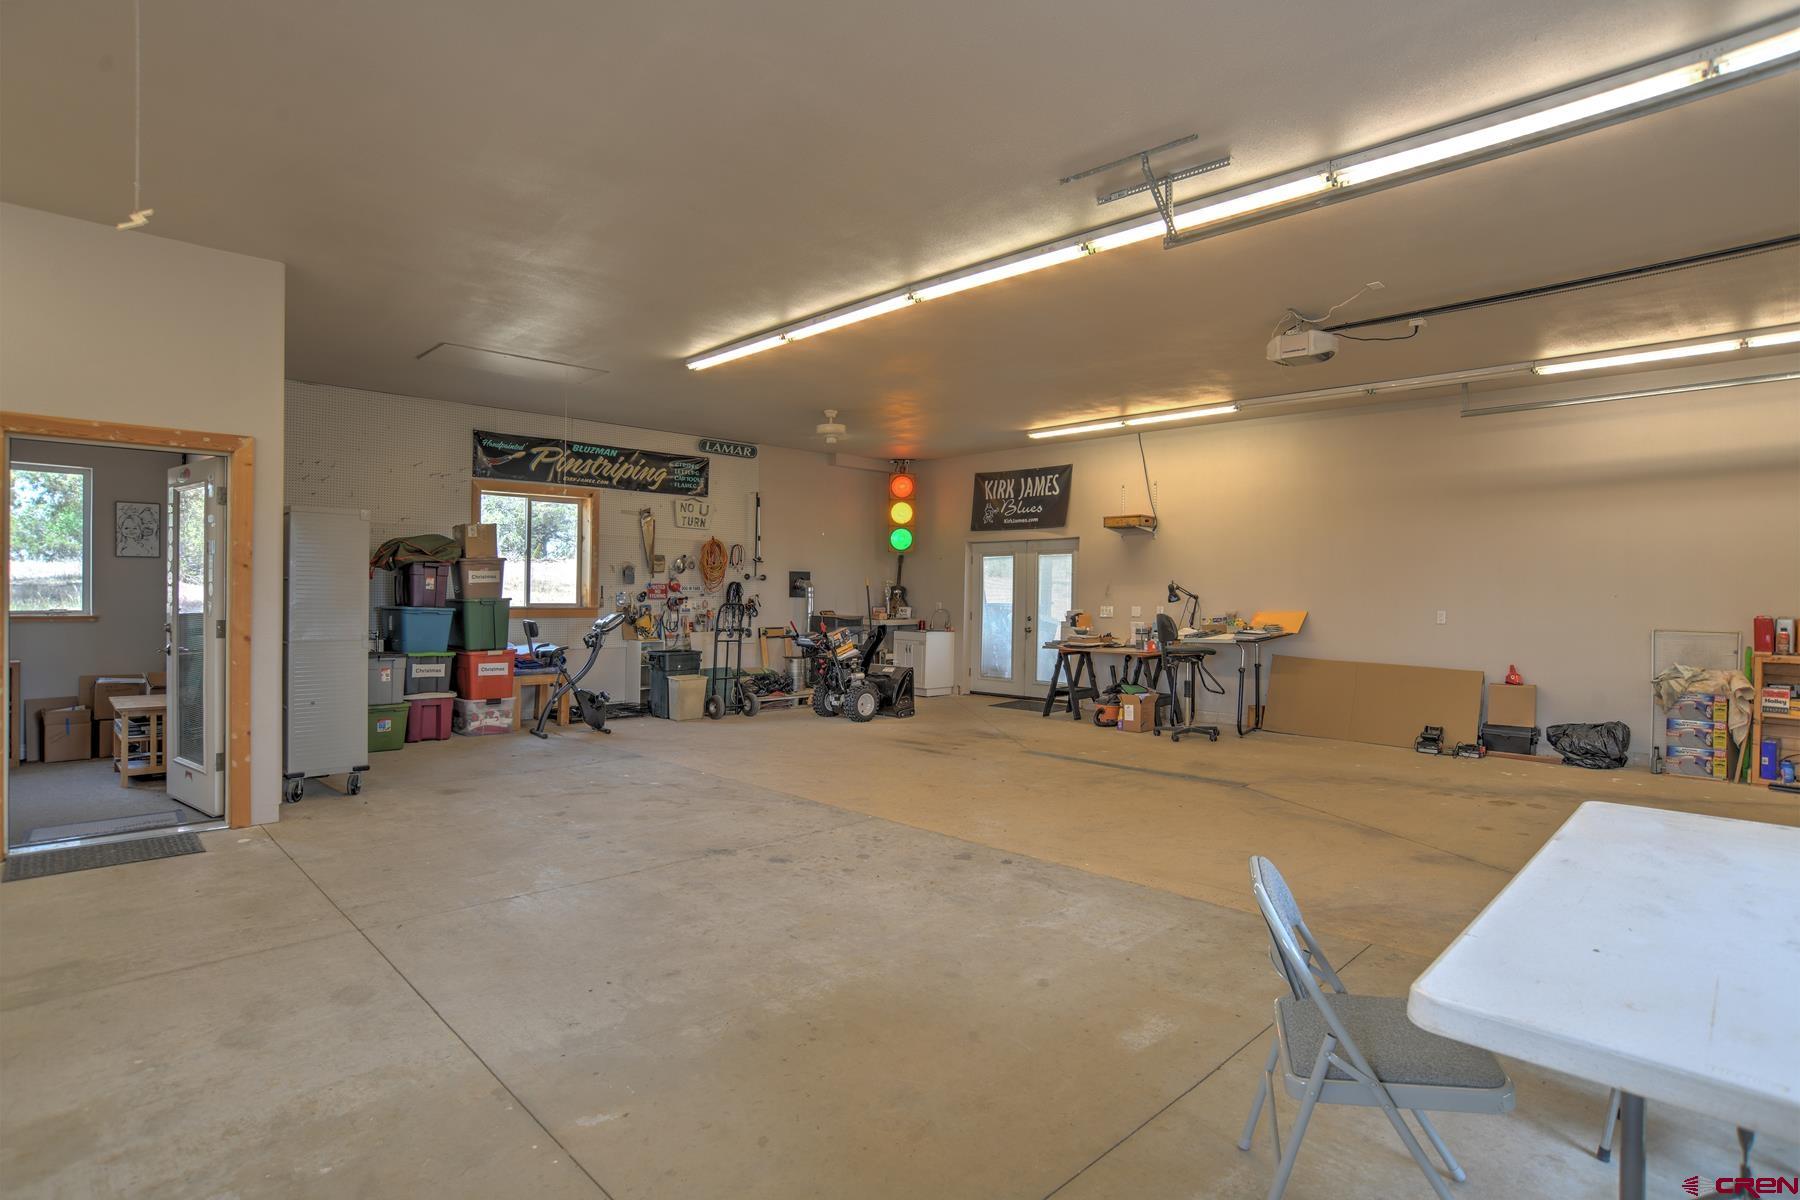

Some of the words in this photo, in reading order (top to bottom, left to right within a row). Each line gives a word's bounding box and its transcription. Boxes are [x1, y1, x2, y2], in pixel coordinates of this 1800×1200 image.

[572, 444, 618, 457] BLUZMAN
[705, 441, 752, 457] LAMAR
[530, 446, 668, 490] Pinstriping
[984, 479, 1015, 500] KIRK
[1019, 474, 1060, 500] JAMES
[680, 503, 695, 513] NO
[699, 504, 710, 516] U
[1000, 499, 1043, 516] Blues
[682, 516, 707, 528] TURN
[1764, 698, 1787, 706] Holley
